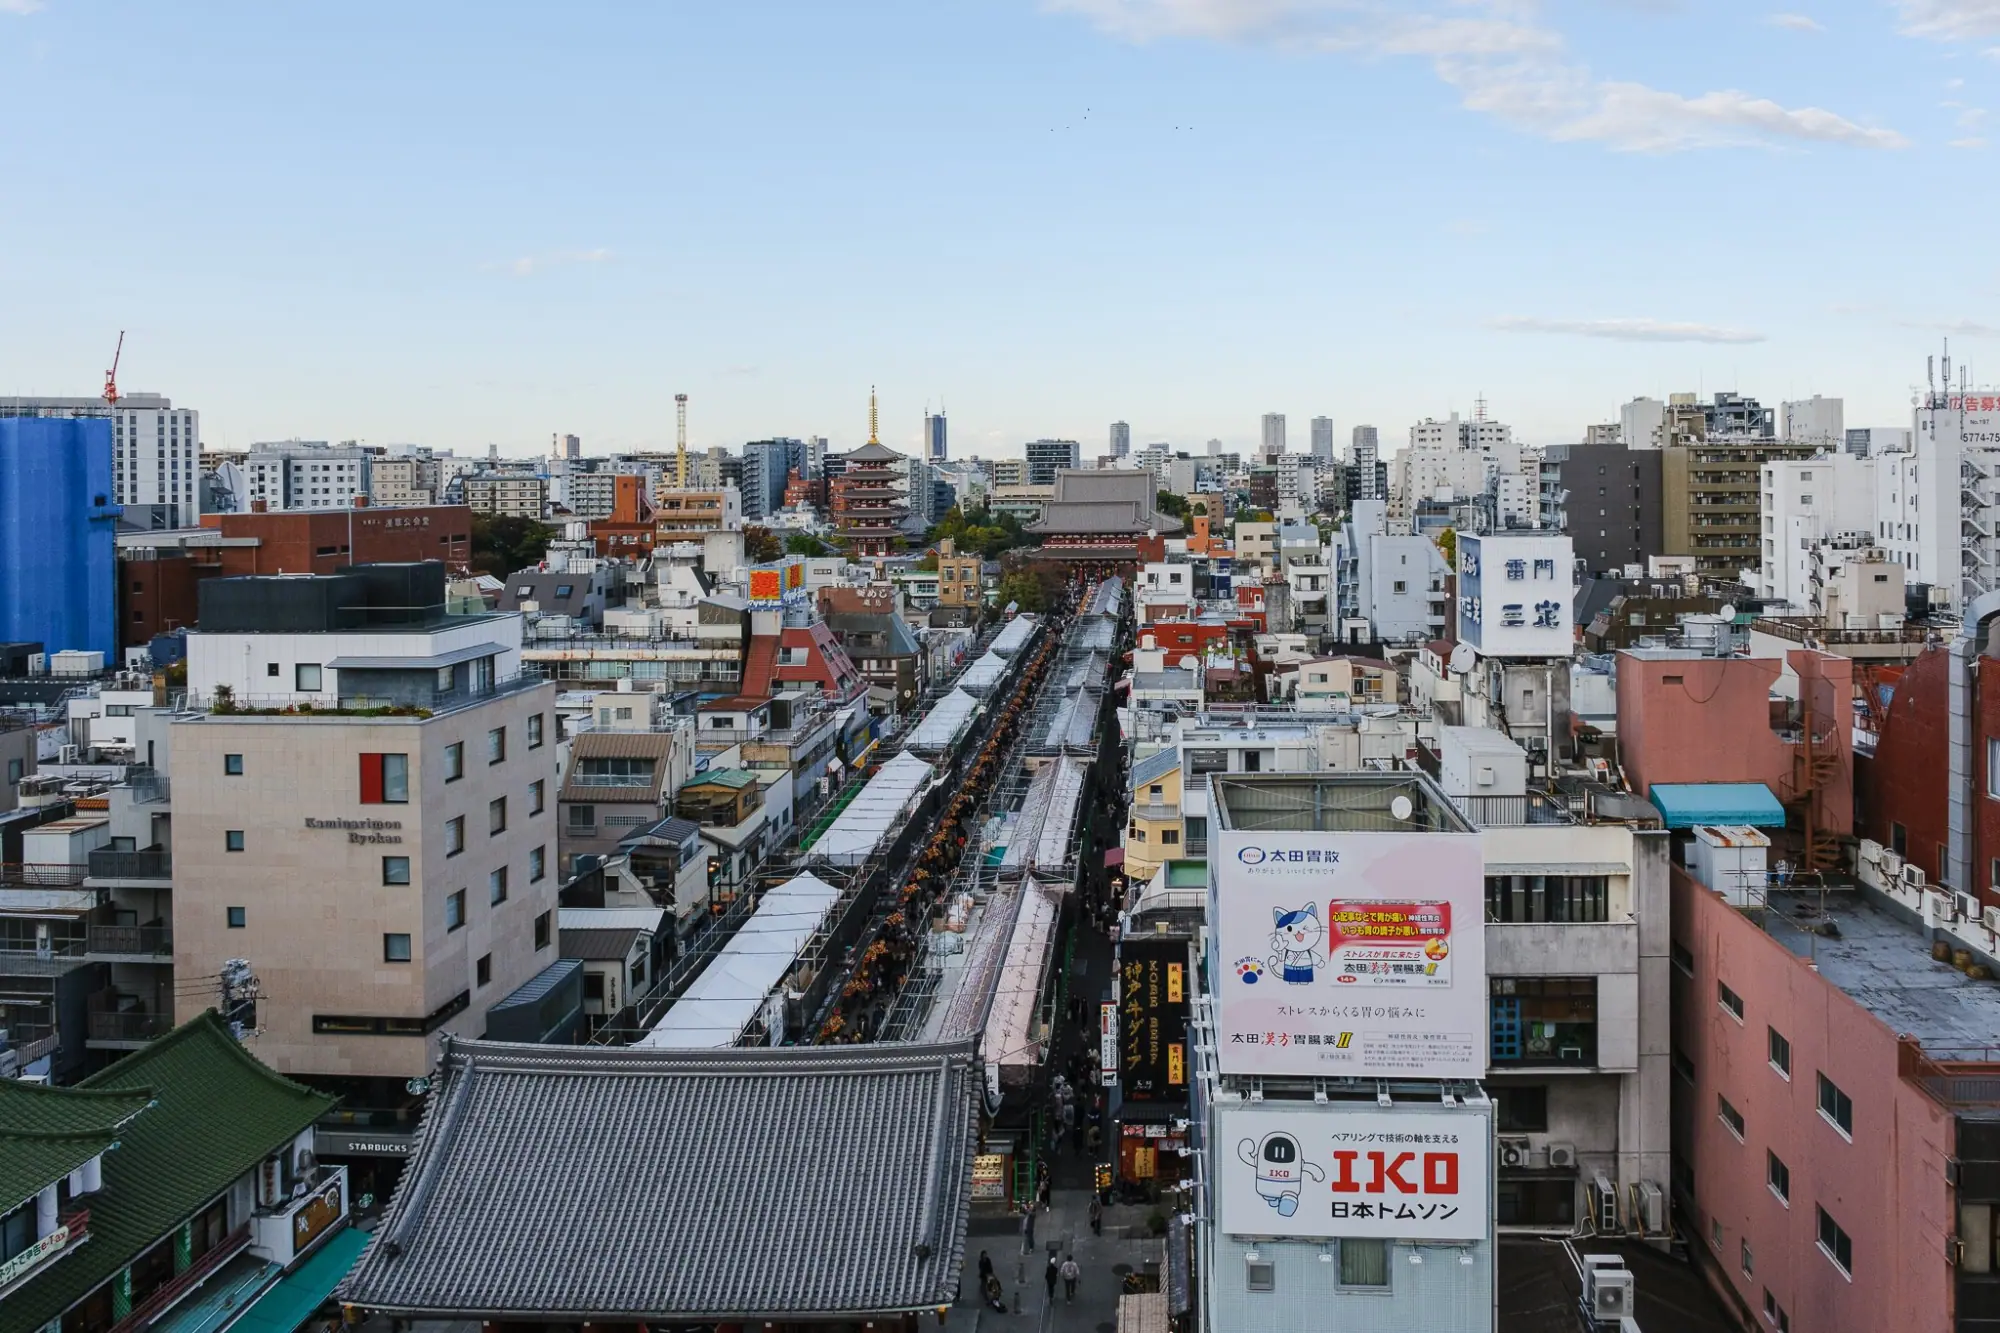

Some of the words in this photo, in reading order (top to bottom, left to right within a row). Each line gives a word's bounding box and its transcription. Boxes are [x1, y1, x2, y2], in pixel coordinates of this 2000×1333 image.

[1949, 395, 2000, 411] 広告募
[1505, 558, 1554, 580] 雷門
[305, 817, 402, 829] Kaminarimon
[348, 832, 402, 845] Ryokan
[1270, 849, 1340, 863] 太田胃散
[1149, 960, 1159, 1008] KOBE
[1277, 1006, 1425, 1018] ストレスからくる胃の悩みに
[1109, 1006, 1117, 1036] KOBE
[1149, 1016, 1159, 1066] BEEF
[1109, 1038, 1117, 1068] BEEF
[1331, 1132, 1459, 1144] ベアリングで技術の軸を支える
[349, 1142, 407, 1152] STARBUCKS
[1269, 1169, 1290, 1178] IKO
[1332, 1150, 1459, 1195] IKO
[1331, 1201, 1459, 1220] 日本トムソン
